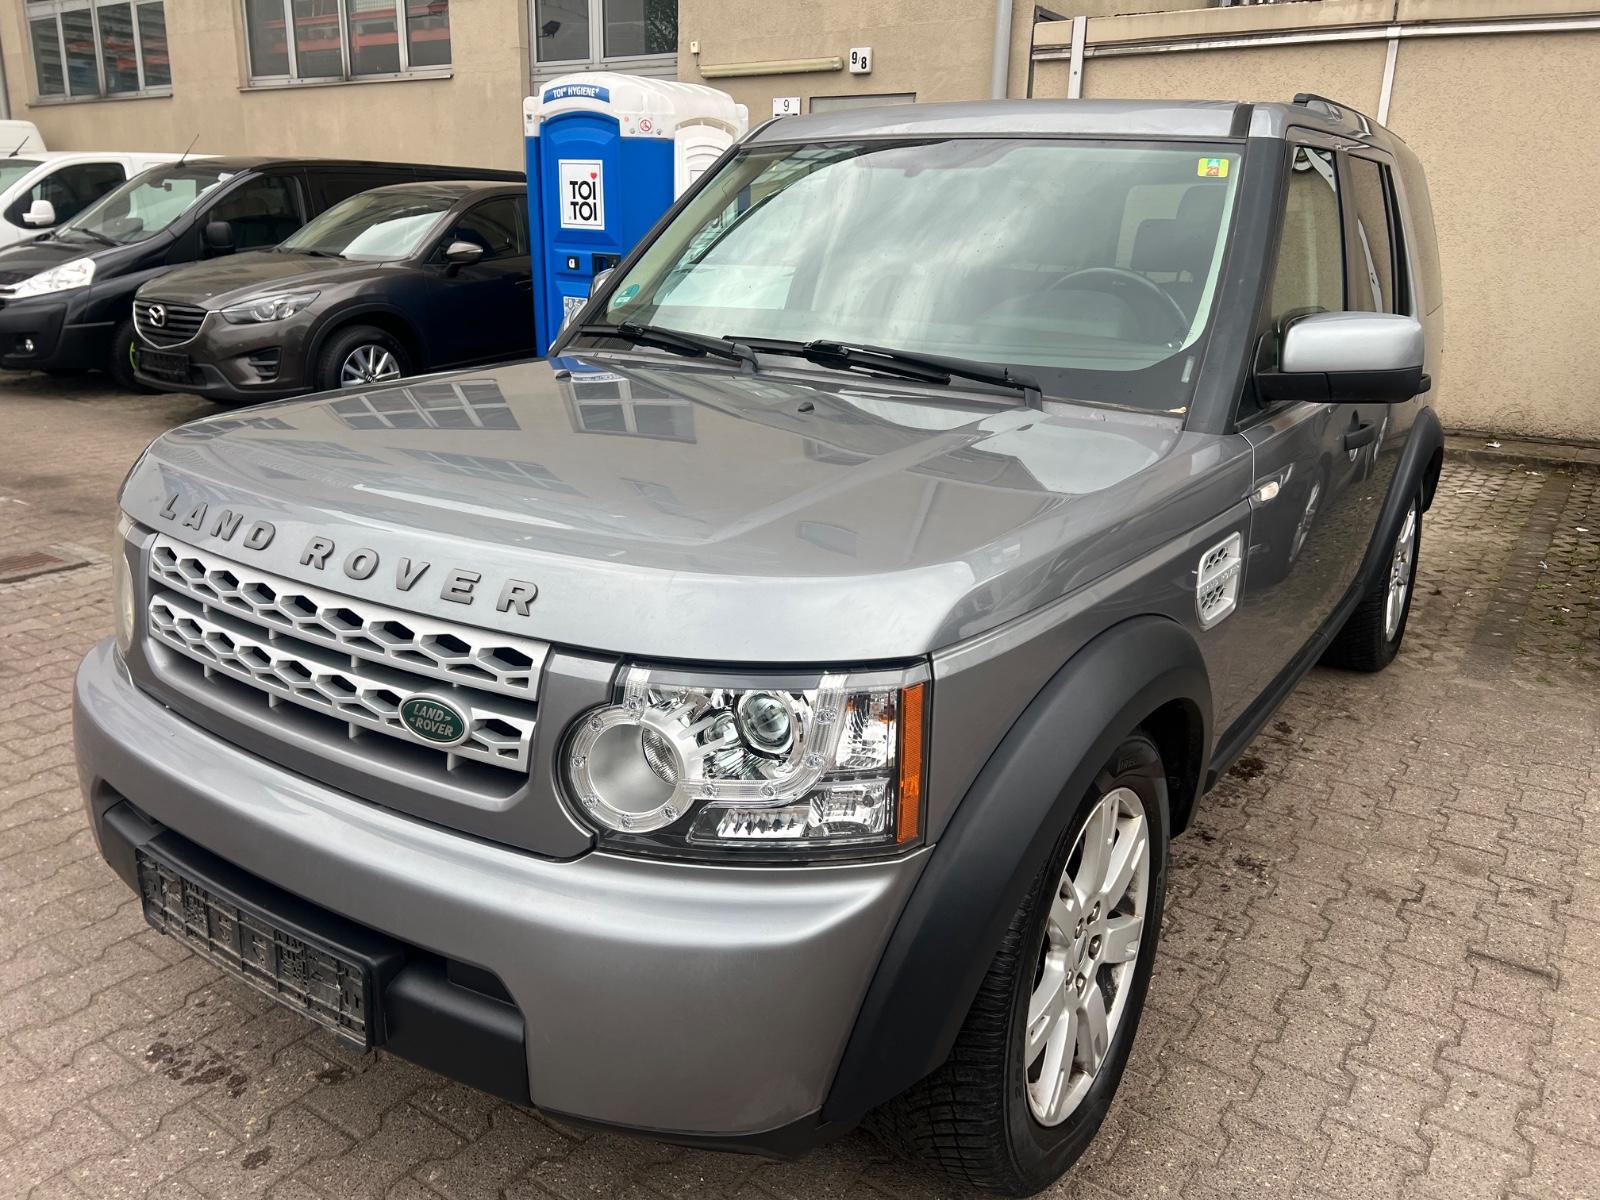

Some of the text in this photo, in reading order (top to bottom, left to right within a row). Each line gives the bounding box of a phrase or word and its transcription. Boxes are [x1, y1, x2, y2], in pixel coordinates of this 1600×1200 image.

[783, 99, 790, 112] 9
[569, 180, 597, 200] TOI
[570, 201, 598, 221] TOI
[159, 493, 539, 617] LAND ROVER
[413, 703, 445, 721] LAND
[415, 717, 454, 737] ROVER
